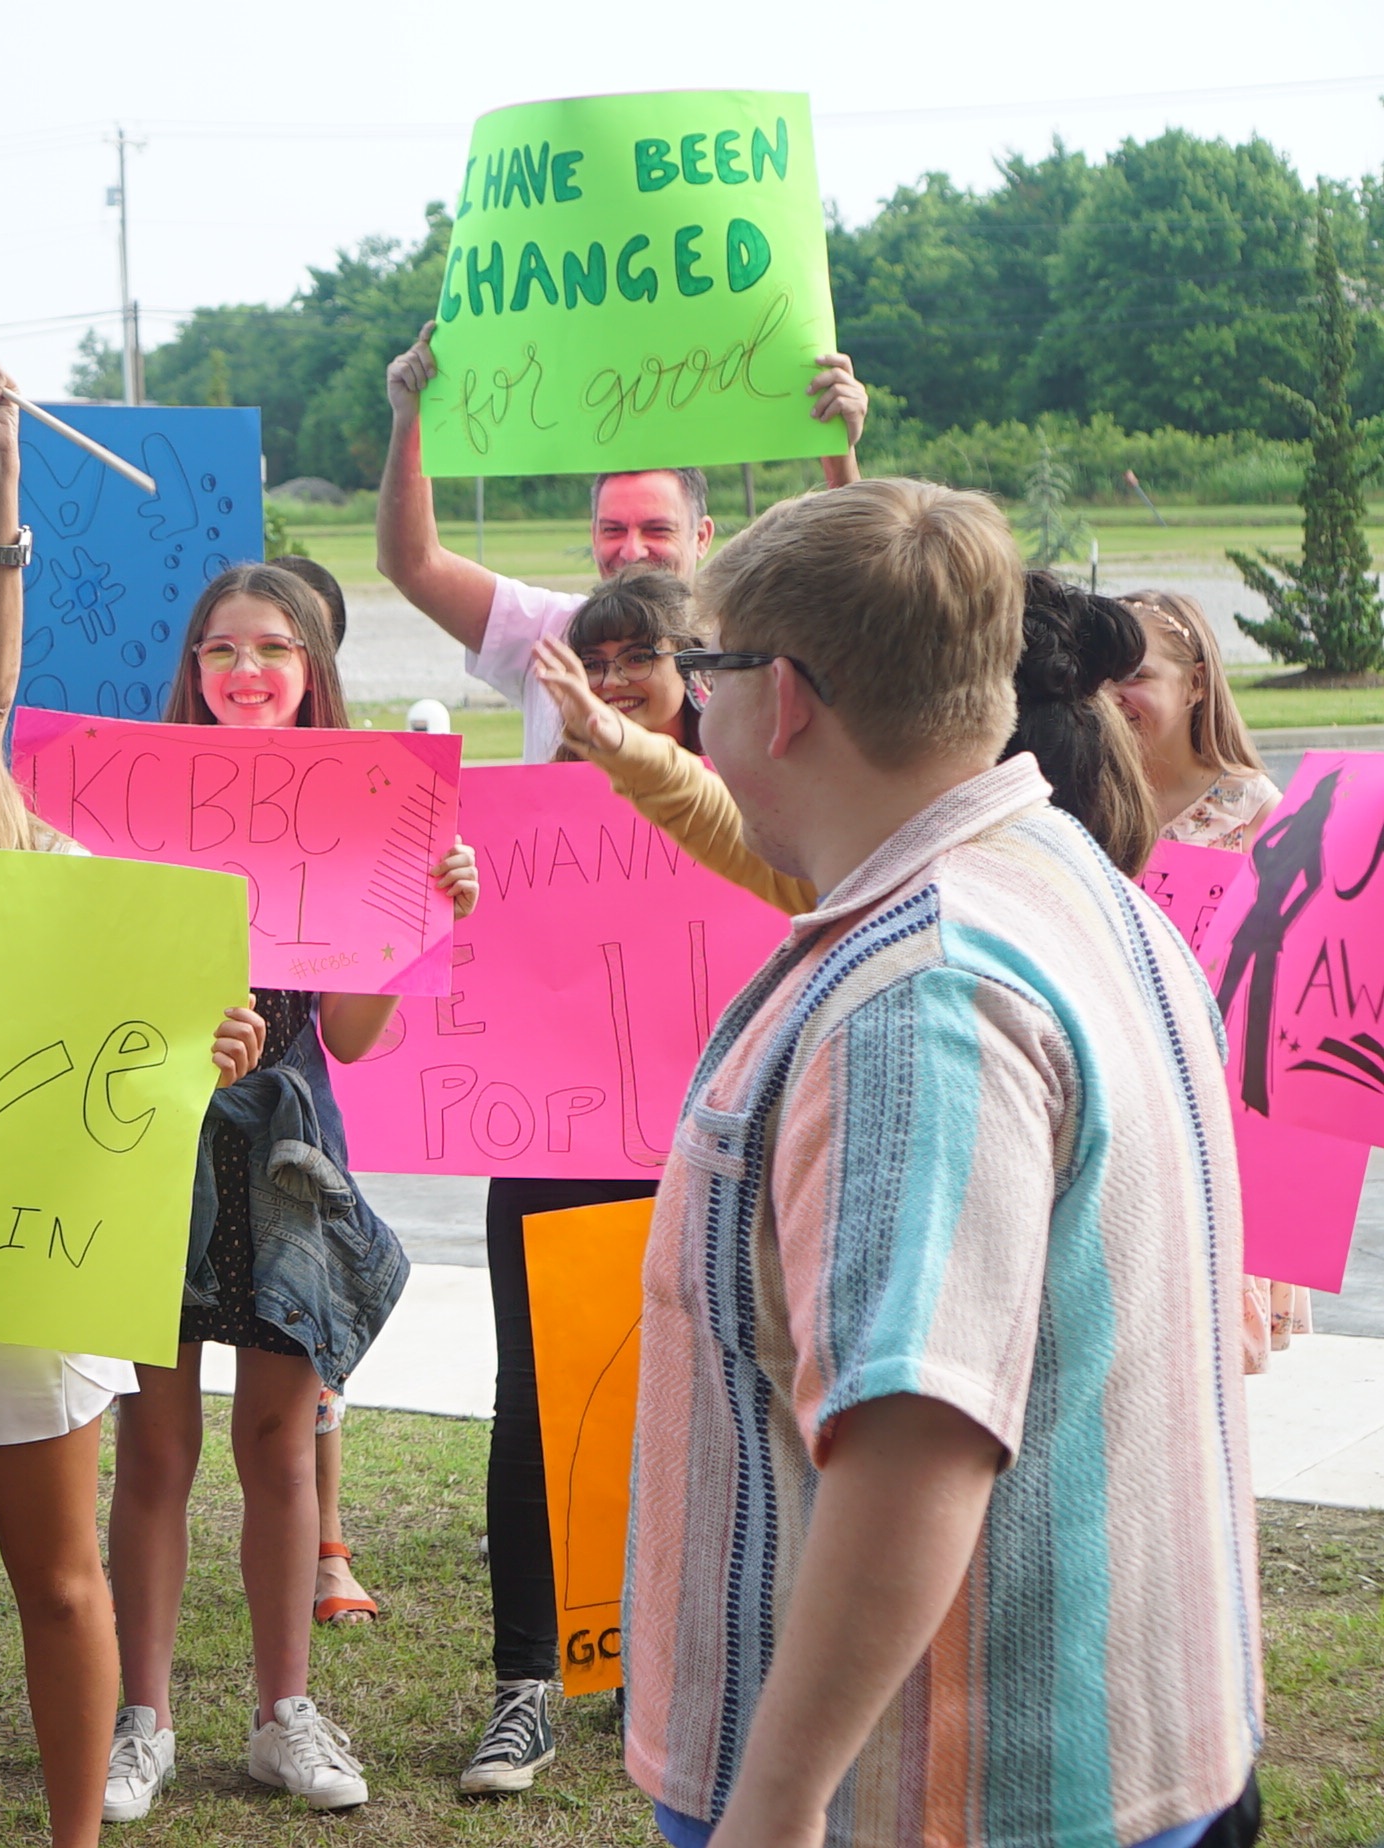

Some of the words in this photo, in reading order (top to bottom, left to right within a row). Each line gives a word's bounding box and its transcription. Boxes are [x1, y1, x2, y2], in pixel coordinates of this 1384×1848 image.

[458, 156, 477, 219] I
[483, 140, 584, 211] HAVE
[635, 116, 788, 192] BEEN
[441, 218, 771, 322] CHANGED
[464, 344, 559, 455] for
[582, 288, 792, 445] good
[485, 817, 699, 900] WANN
[289, 952, 359, 979] #KCBBC
